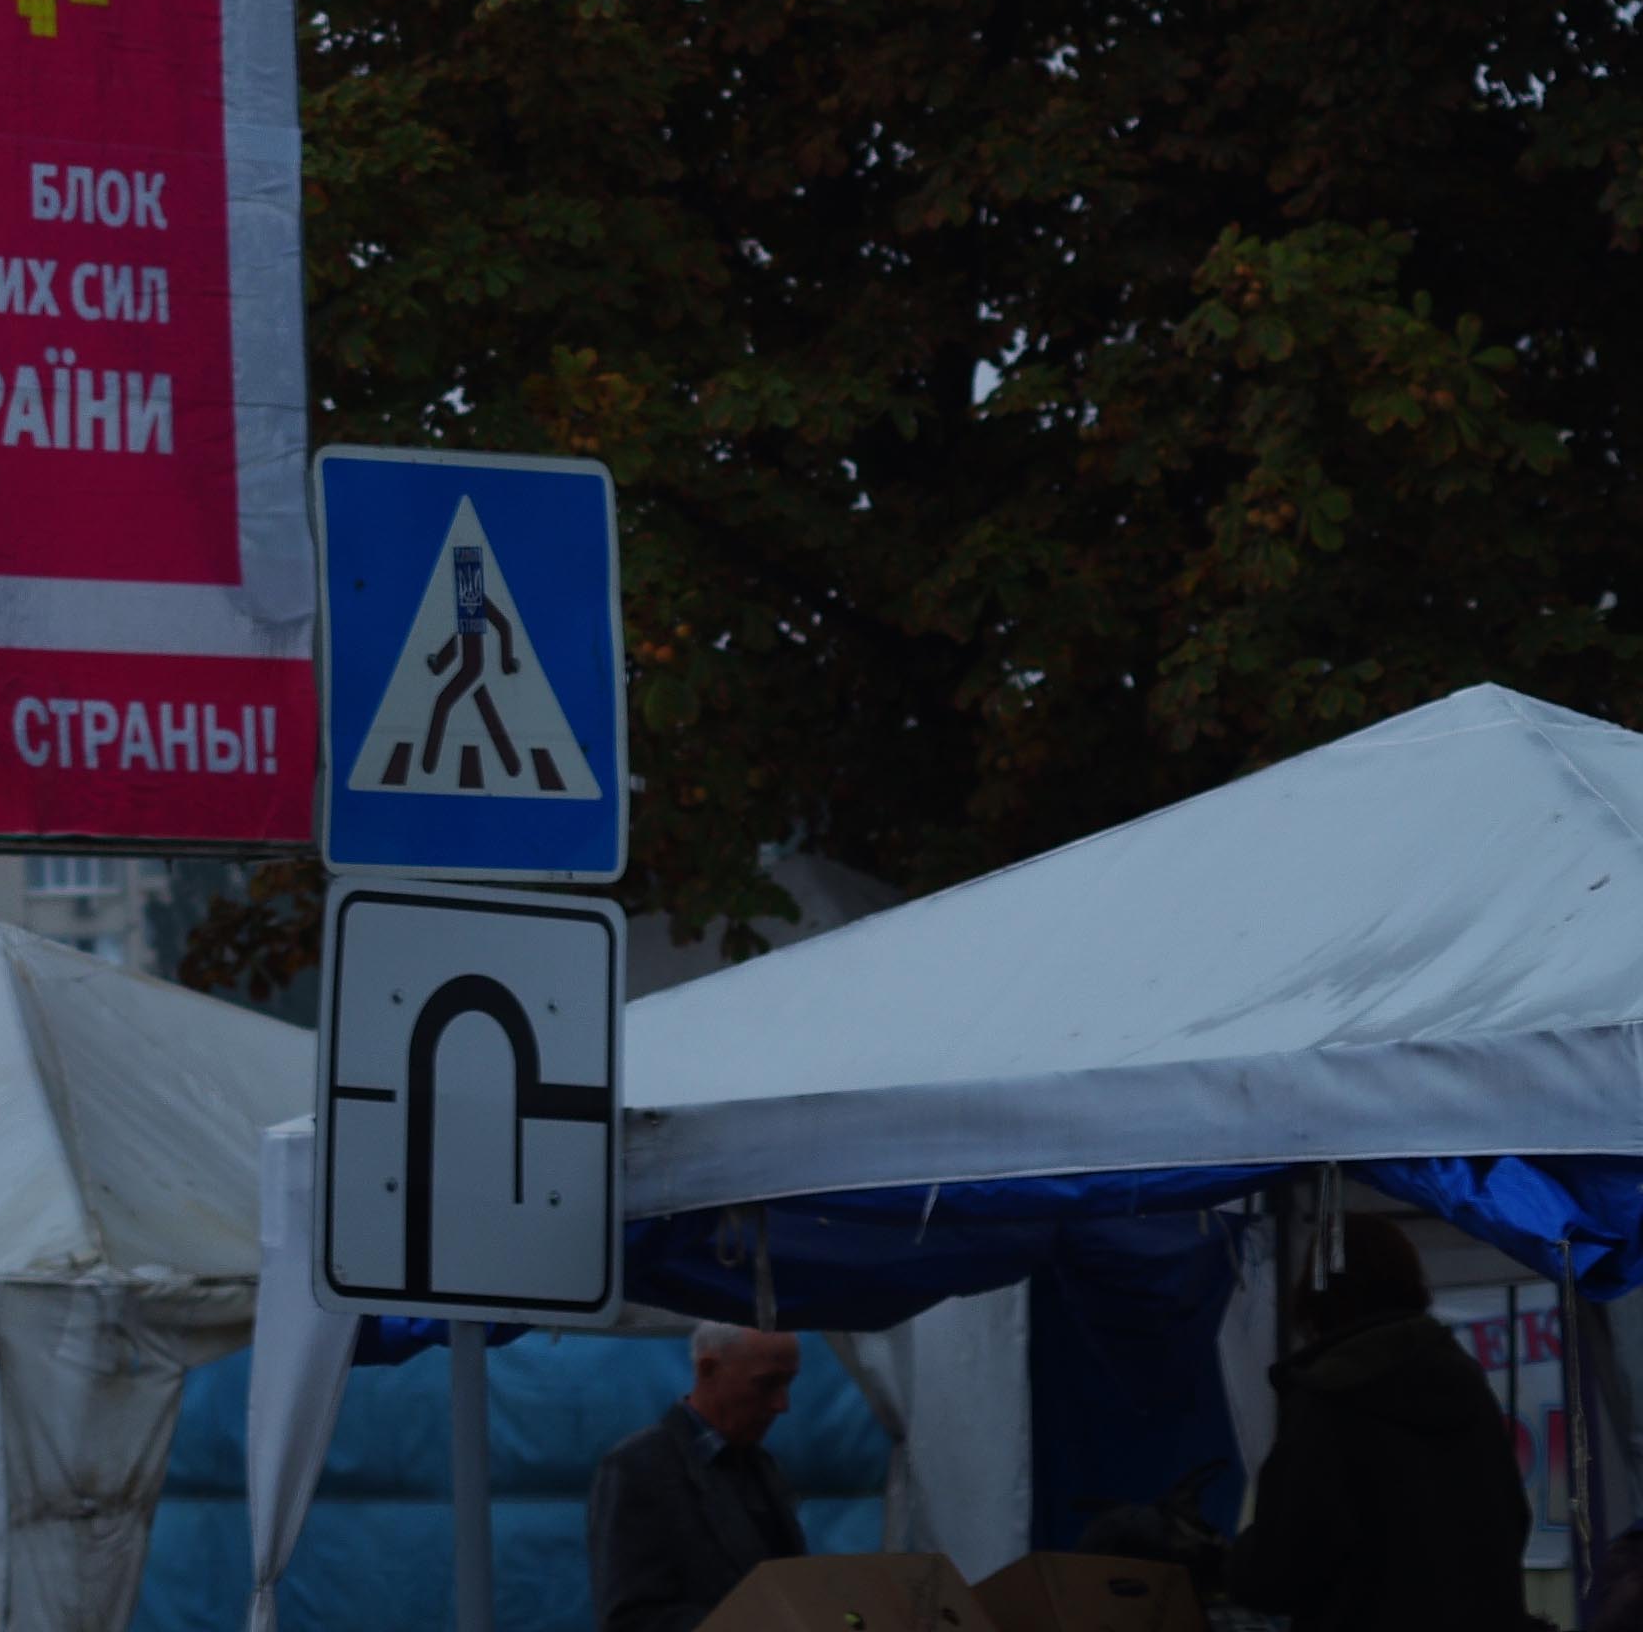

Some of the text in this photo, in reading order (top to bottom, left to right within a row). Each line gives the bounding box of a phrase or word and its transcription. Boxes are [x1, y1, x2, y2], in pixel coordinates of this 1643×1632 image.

[30, 161, 168, 230] БЛОК
[70, 262, 171, 325] СИЛ
[11, 696, 278, 775] СТРАНЫ!
